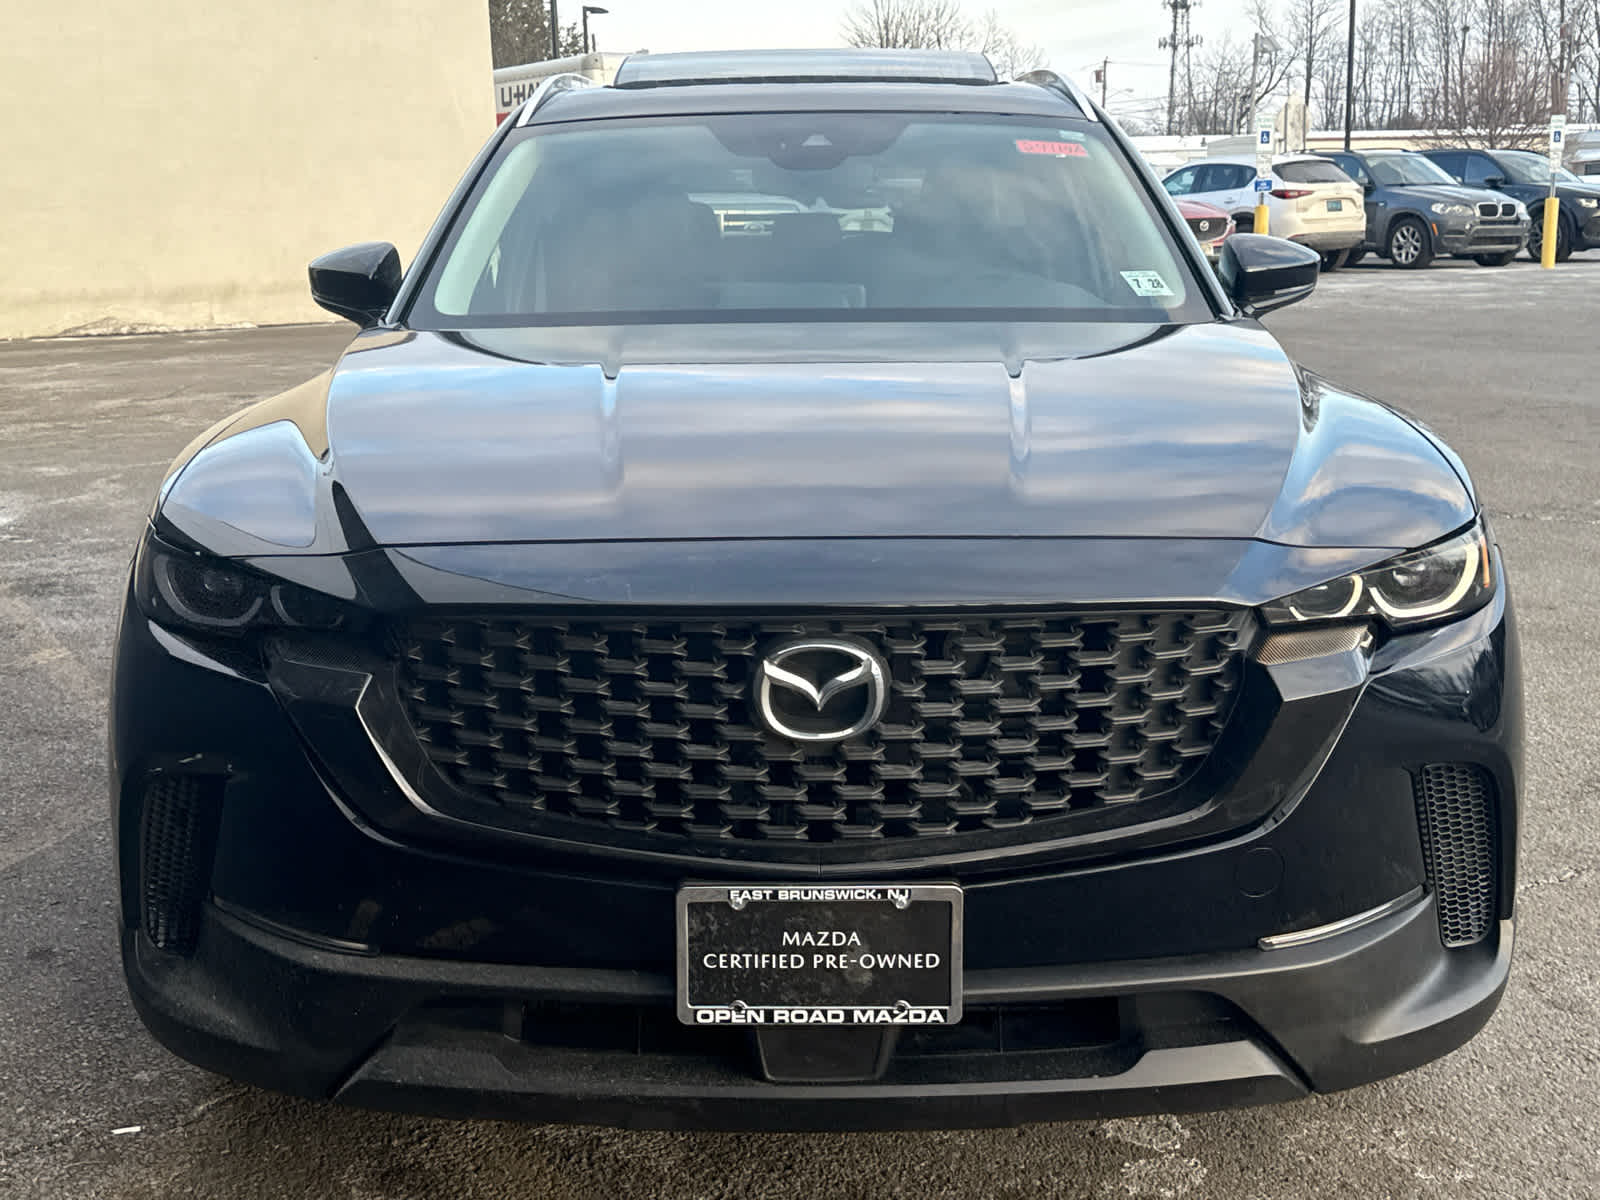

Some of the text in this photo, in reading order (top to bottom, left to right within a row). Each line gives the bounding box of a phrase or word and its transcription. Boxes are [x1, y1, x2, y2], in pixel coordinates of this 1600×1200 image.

[730, 888, 909, 900] EAST BRUNSWICK, NJ
[782, 931, 861, 946] MAZDA
[703, 953, 940, 968] CERTIFIED PRE-OWNED
[696, 1010, 945, 1023] OPEN ROAD MAZDA
